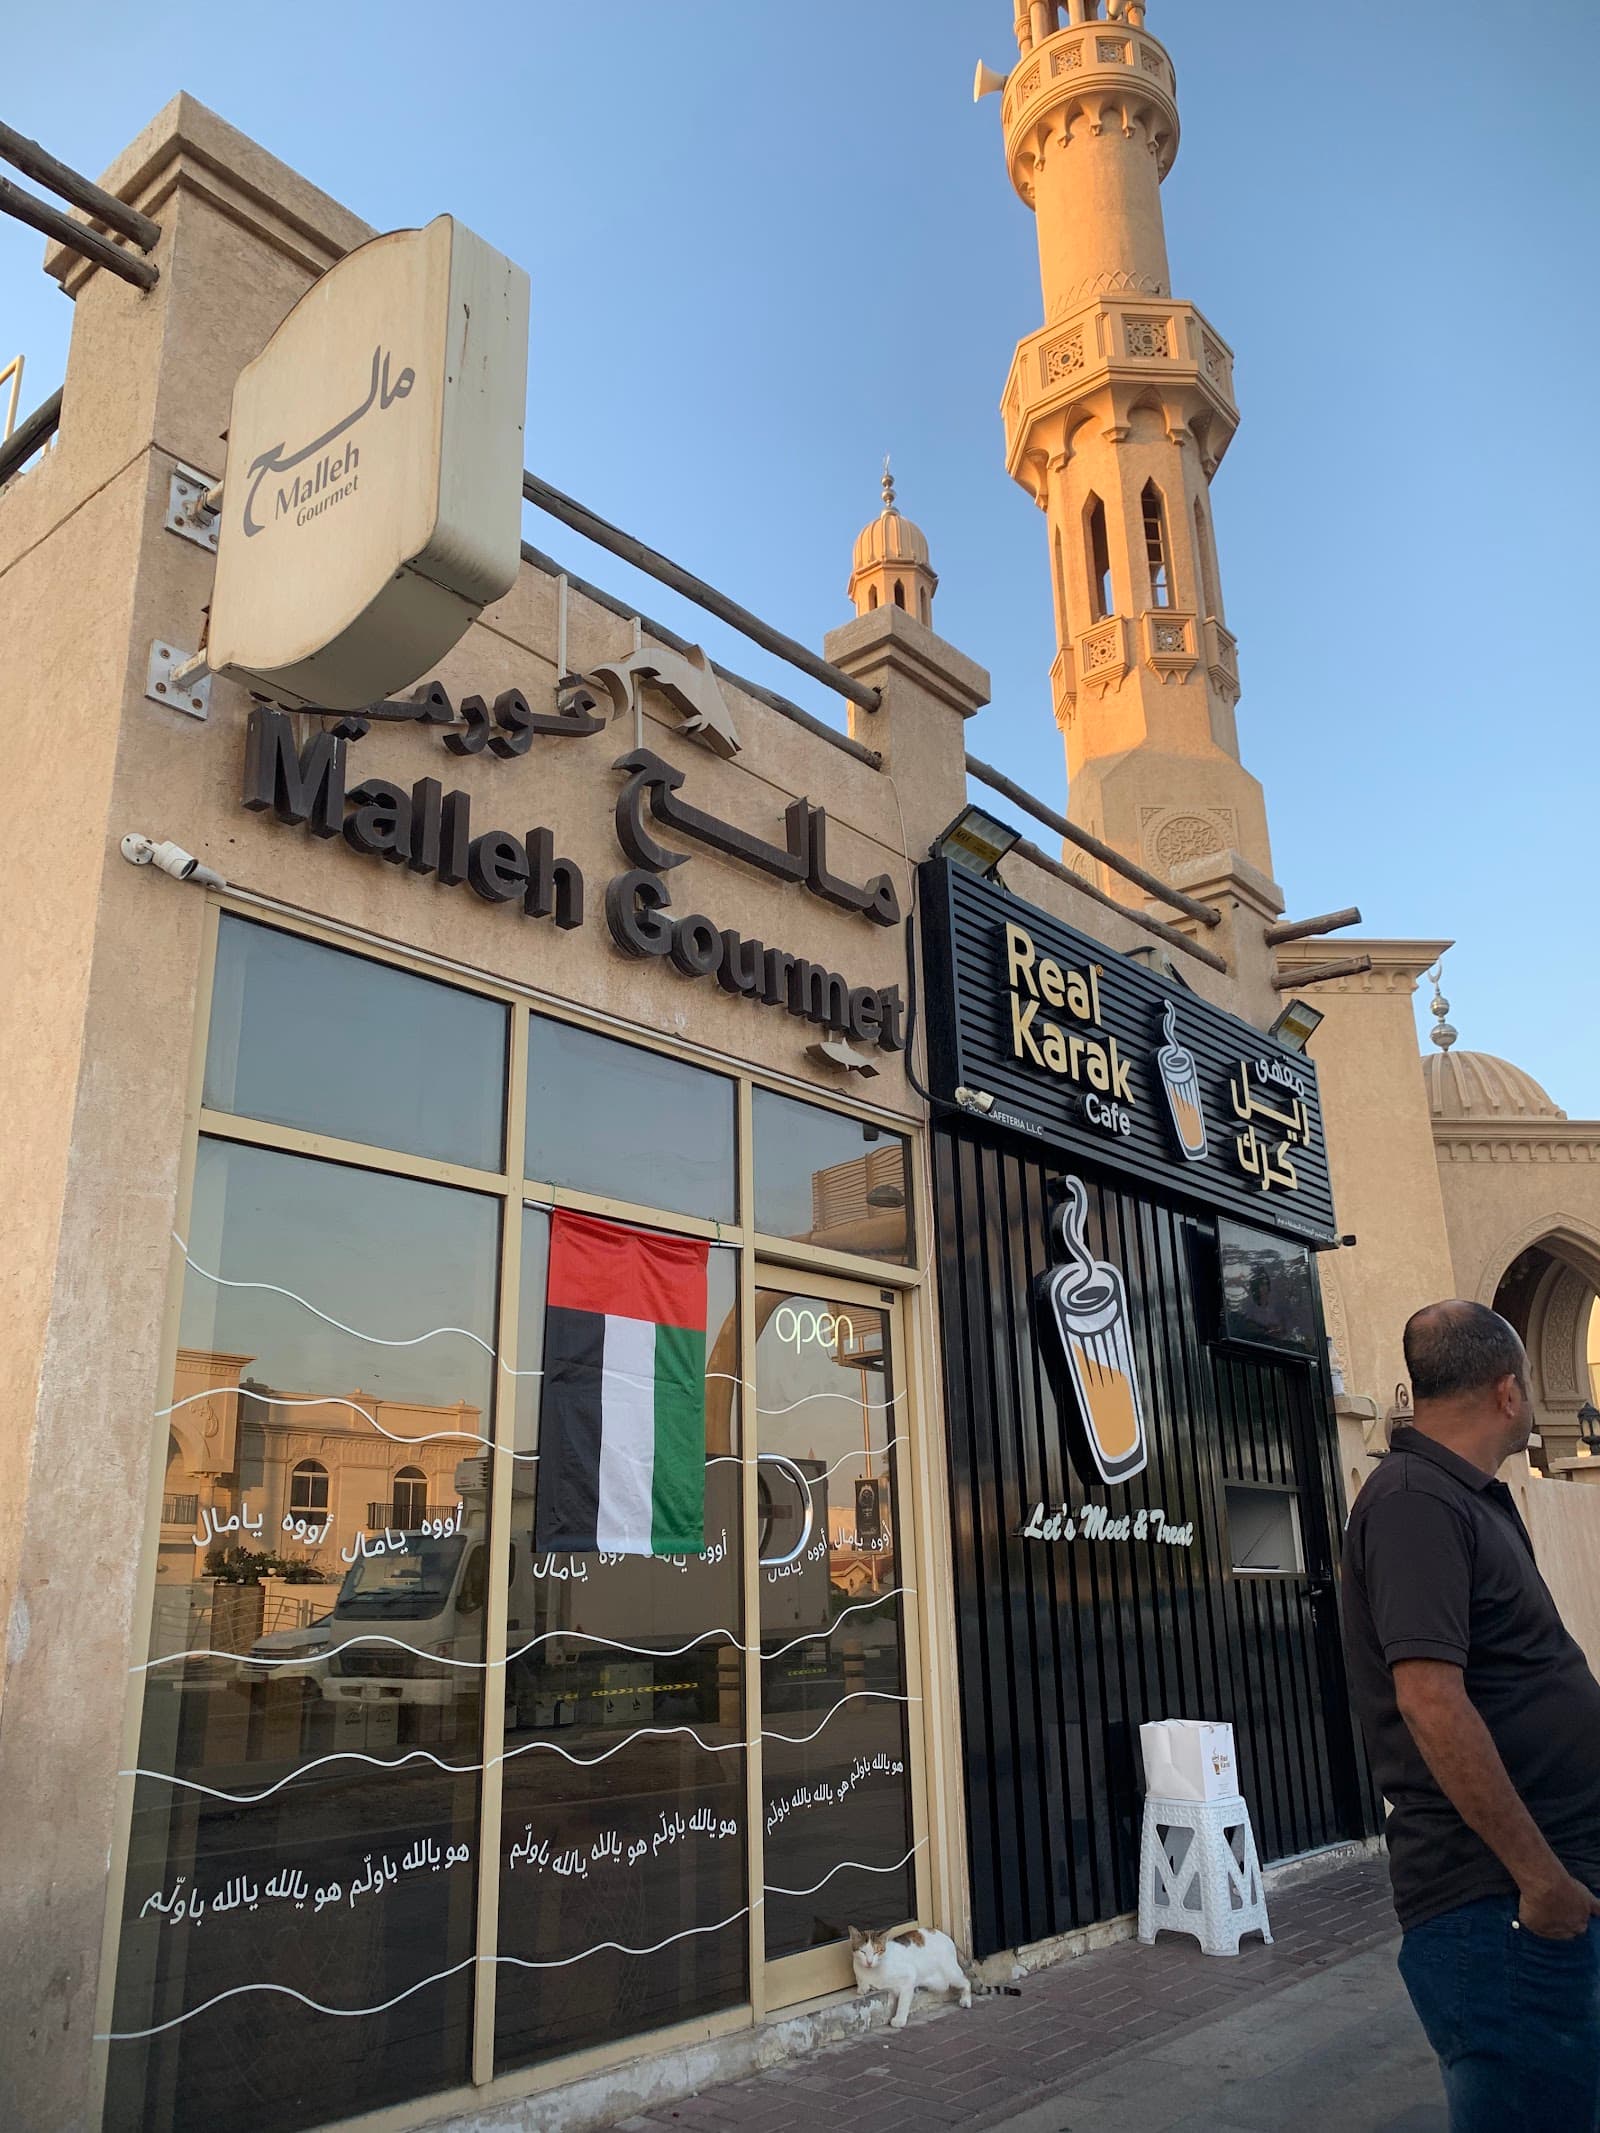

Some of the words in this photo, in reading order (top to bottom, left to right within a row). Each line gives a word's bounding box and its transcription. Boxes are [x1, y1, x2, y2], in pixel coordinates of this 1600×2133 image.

[243, 345, 416, 537] مالح
[275, 440, 360, 520] Malleh
[296, 475, 359, 527] Gourmet
[611, 747, 900, 927] مالح
[243, 705, 584, 930] Malleh
[606, 868, 904, 1052] Gourmet
[1006, 921, 1102, 1026] Real
[1010, 990, 1135, 1104] Karak
[1255, 1055, 1305, 1098] مقهى
[1085, 1092, 1131, 1136] Cafe
[1230, 1060, 1311, 1146] ريل
[1236, 1125, 1298, 1191] كرك
[775, 1307, 854, 1355] open
[282, 1512, 335, 1545] أووه
[421, 1501, 463, 1540] أووه
[1024, 1502, 1076, 1541] Let's
[1081, 1503, 1130, 1541] Meet
[1133, 1508, 1148, 1541] &
[1150, 1509, 1193, 1547] Treat
[627, 1840, 647, 1866] هو
[719, 1819, 737, 1839] هو
[444, 1843, 470, 1869] هو
[314, 1882, 342, 1913] هو
